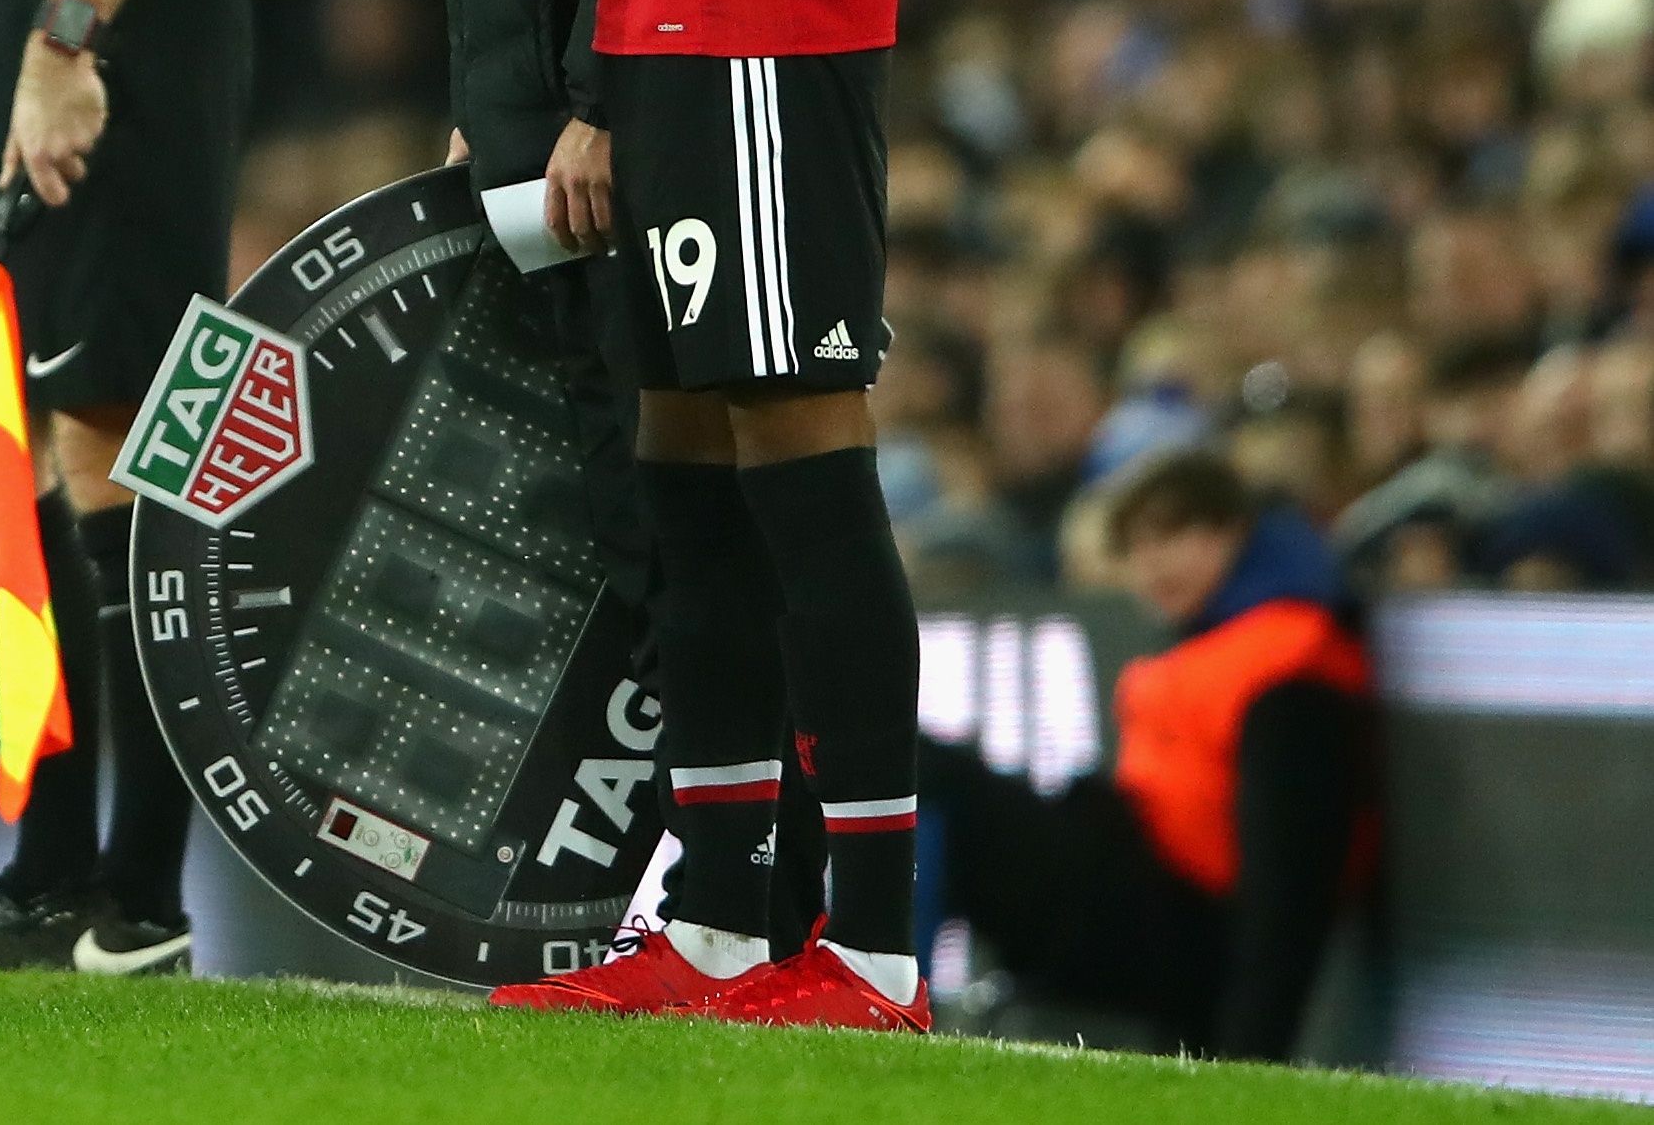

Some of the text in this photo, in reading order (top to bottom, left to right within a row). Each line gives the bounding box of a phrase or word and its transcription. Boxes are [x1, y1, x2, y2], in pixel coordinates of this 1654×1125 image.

[291, 226, 365, 291] 05
[646, 218, 717, 332] 19
[813, 344, 860, 360] adidas
[138, 327, 242, 470] TAG
[194, 347, 293, 507] HEUER
[148, 569, 189, 642] 55
[203, 755, 271, 832] 50
[535, 678, 663, 868] TAG
[346, 890, 426, 944] 45
